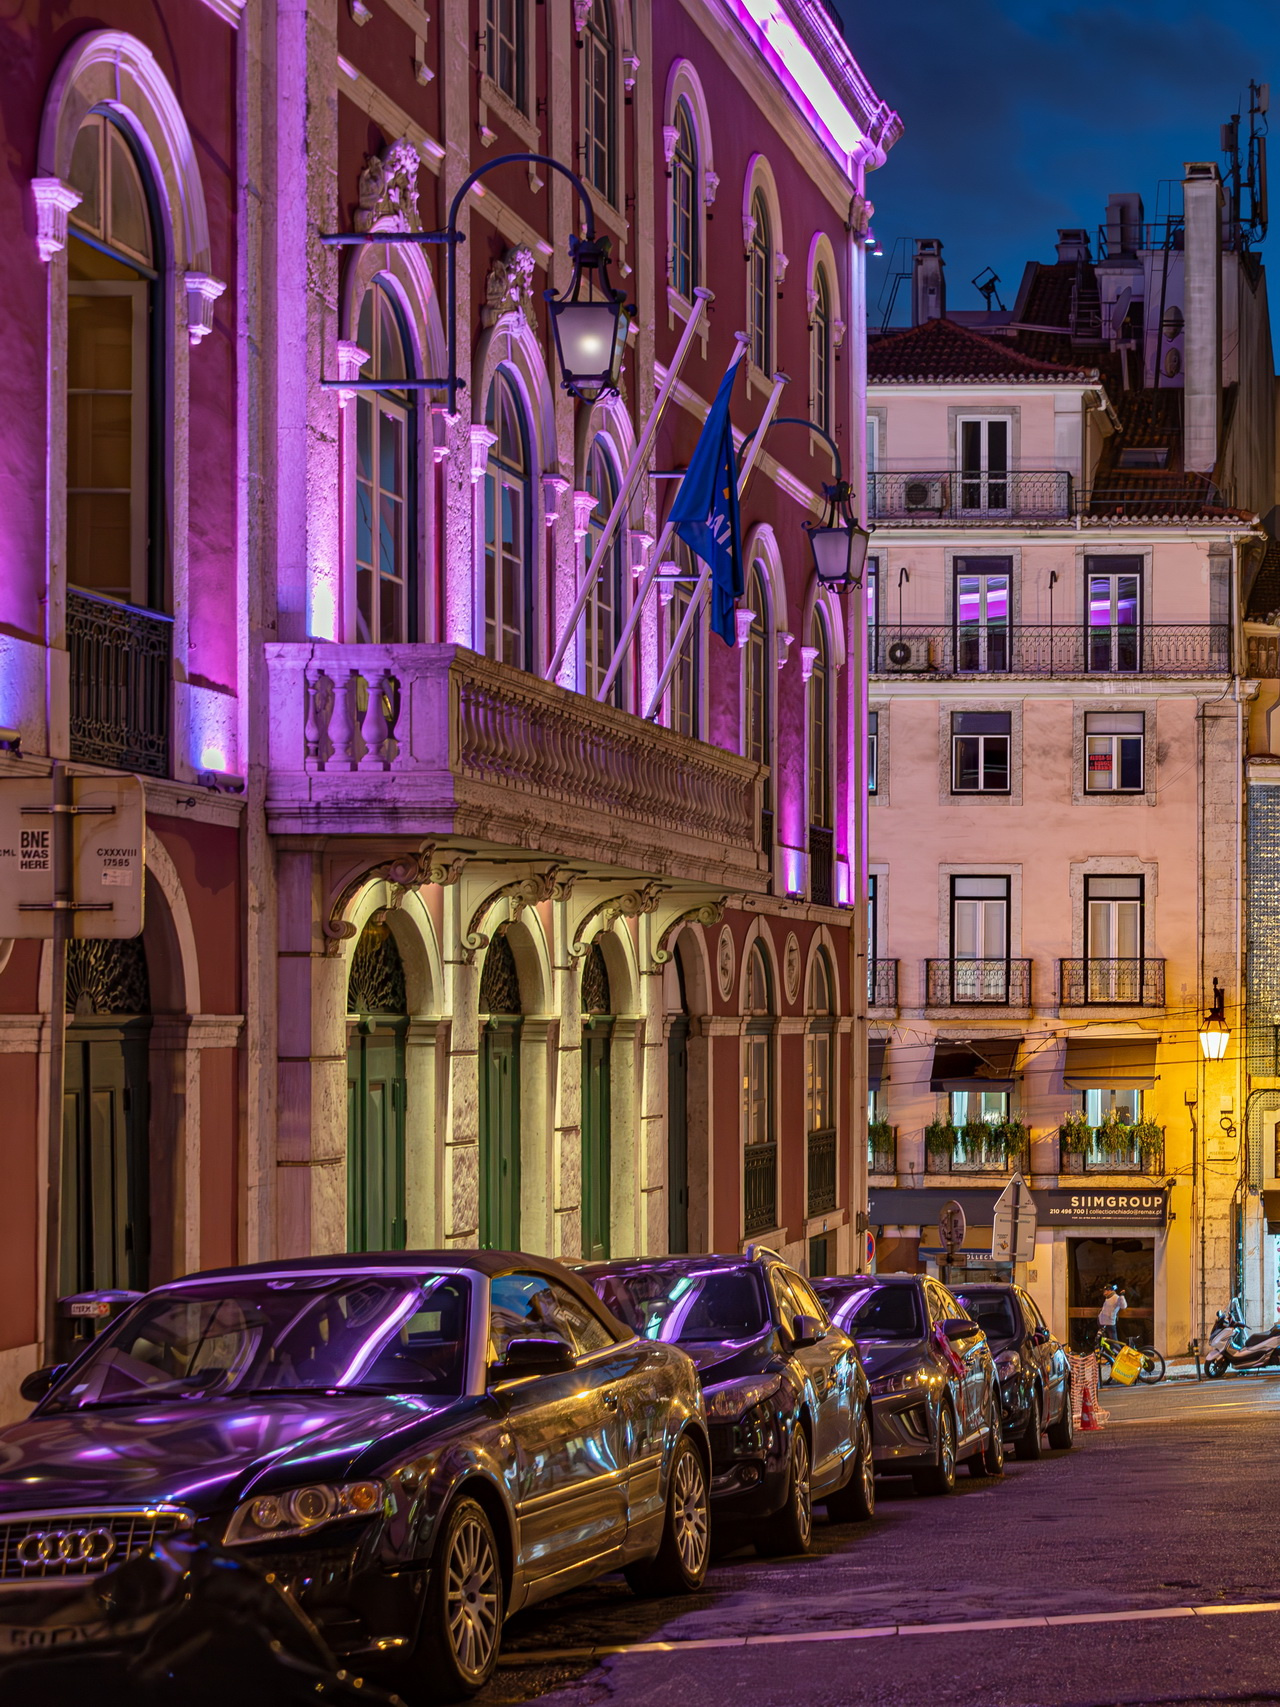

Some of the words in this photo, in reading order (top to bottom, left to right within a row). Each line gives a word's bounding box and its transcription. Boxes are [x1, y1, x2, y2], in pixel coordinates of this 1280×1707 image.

[21, 831, 49, 848] BNE
[21, 849, 49, 859] WAS
[97, 848, 137, 857] CXXXVIII
[21, 860, 49, 869] HERE
[1071, 1196, 1163, 1207] SIIMGROUP
